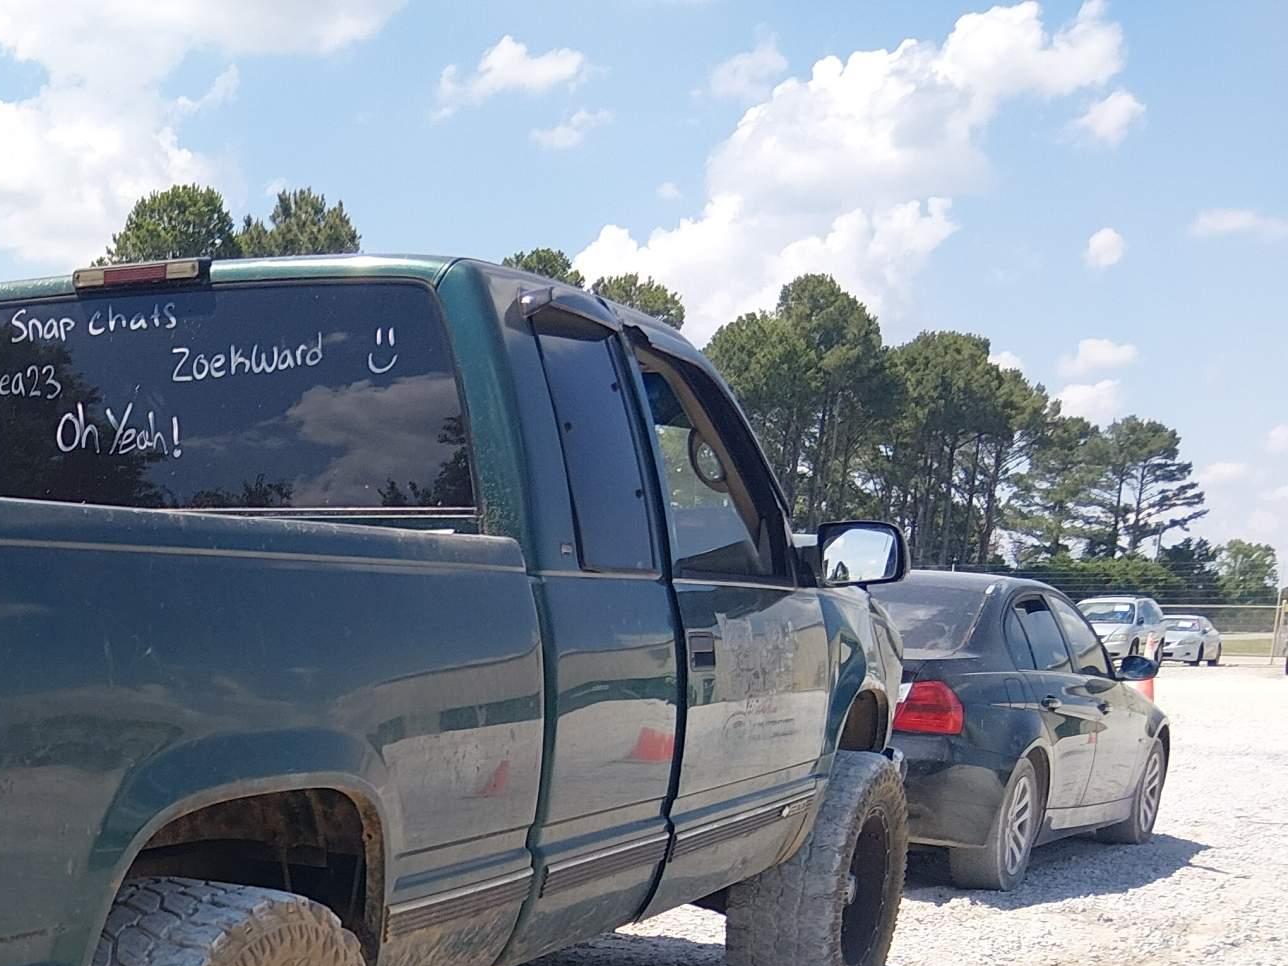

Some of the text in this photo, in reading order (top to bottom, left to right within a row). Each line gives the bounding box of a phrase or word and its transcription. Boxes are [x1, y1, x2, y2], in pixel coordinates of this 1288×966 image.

[11, 308, 75, 343] Snap
[56, 401, 183, 459] Oh Yeah!
